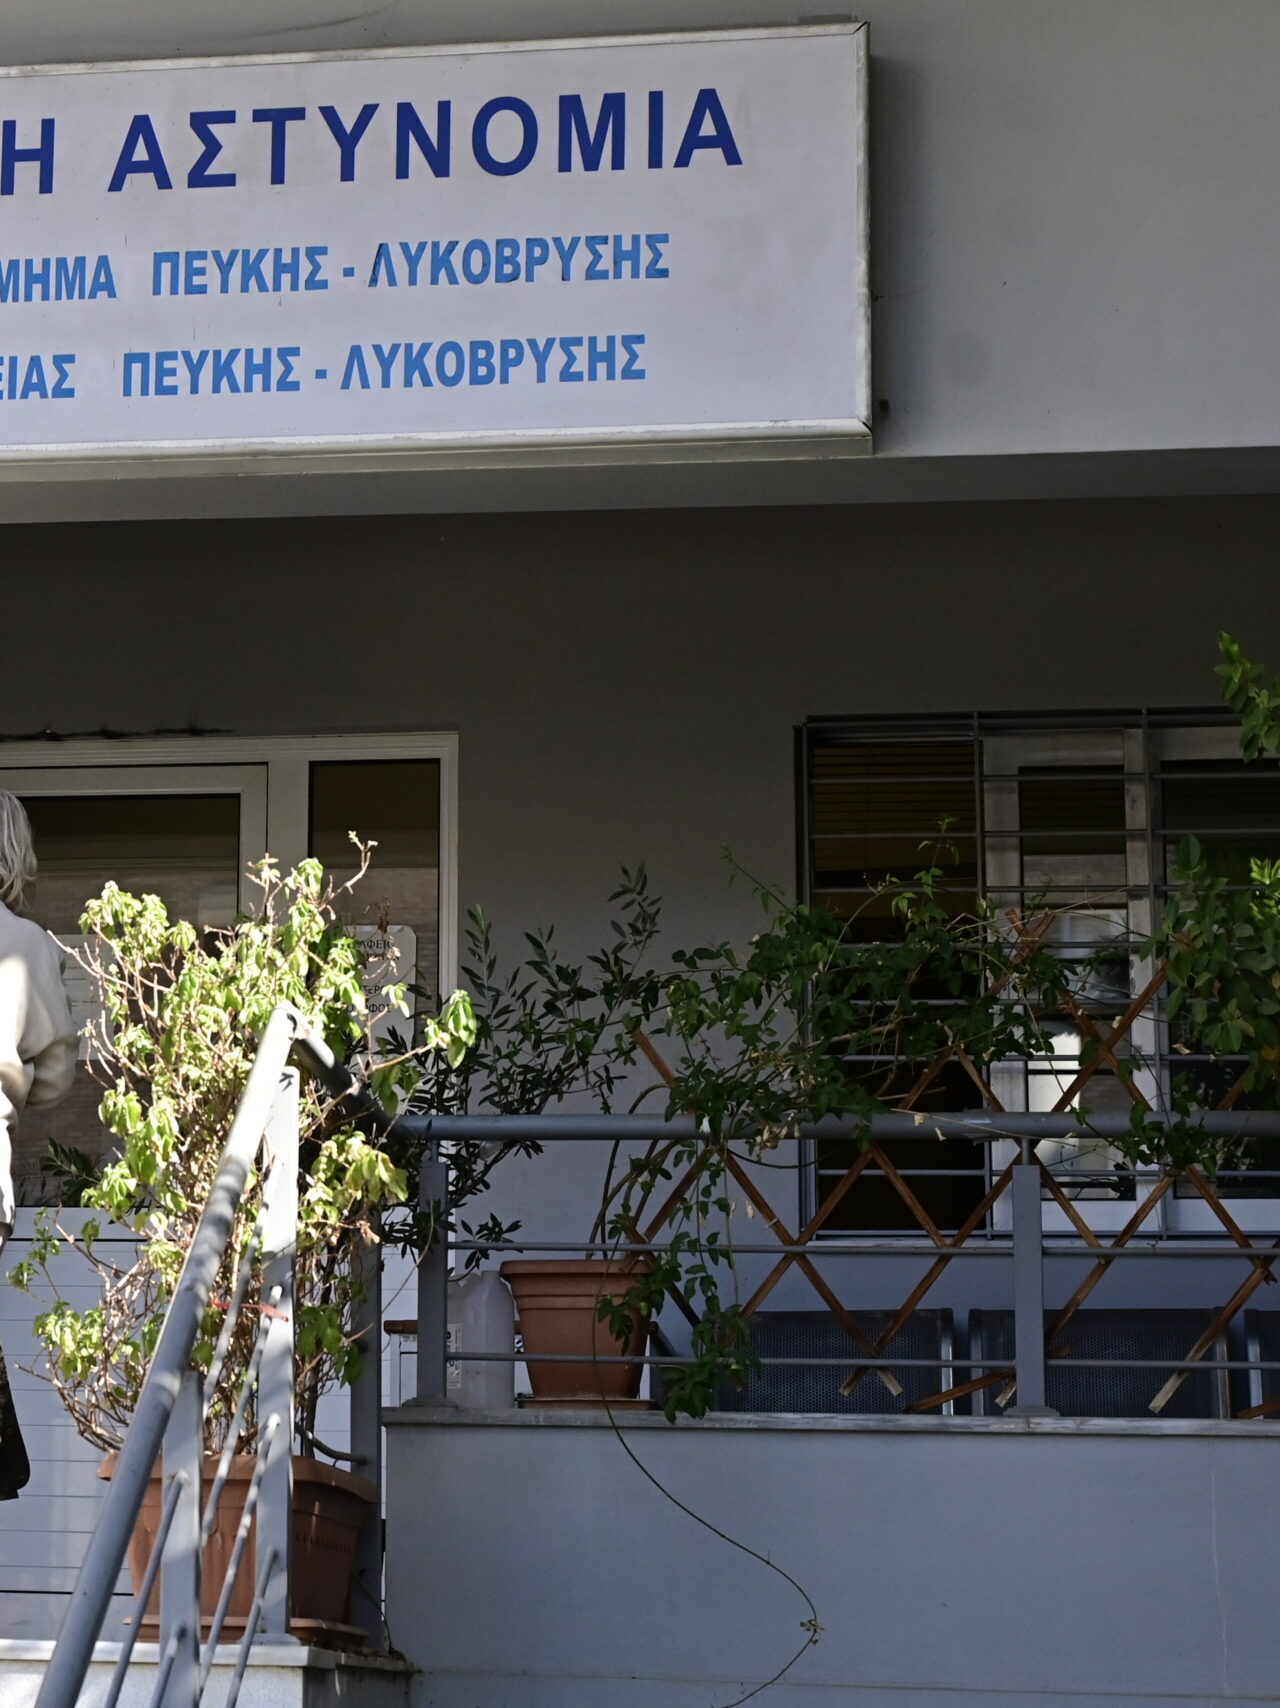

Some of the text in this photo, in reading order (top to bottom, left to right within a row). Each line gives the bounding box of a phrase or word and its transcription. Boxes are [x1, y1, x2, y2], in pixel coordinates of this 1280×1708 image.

[108, 88, 742, 193] ΑΣΤΥΝΟΜΙΑ
[152, 244, 330, 297] ΠΕΥΚΗΣ
[368, 232, 672, 289] ΛΥΚΟΒΡΥΣΗΣ
[121, 345, 303, 399] ΠΕΥΚΗΣ
[340, 332, 648, 391] ΛΥΚΟΒΡΥΣΗΣ
